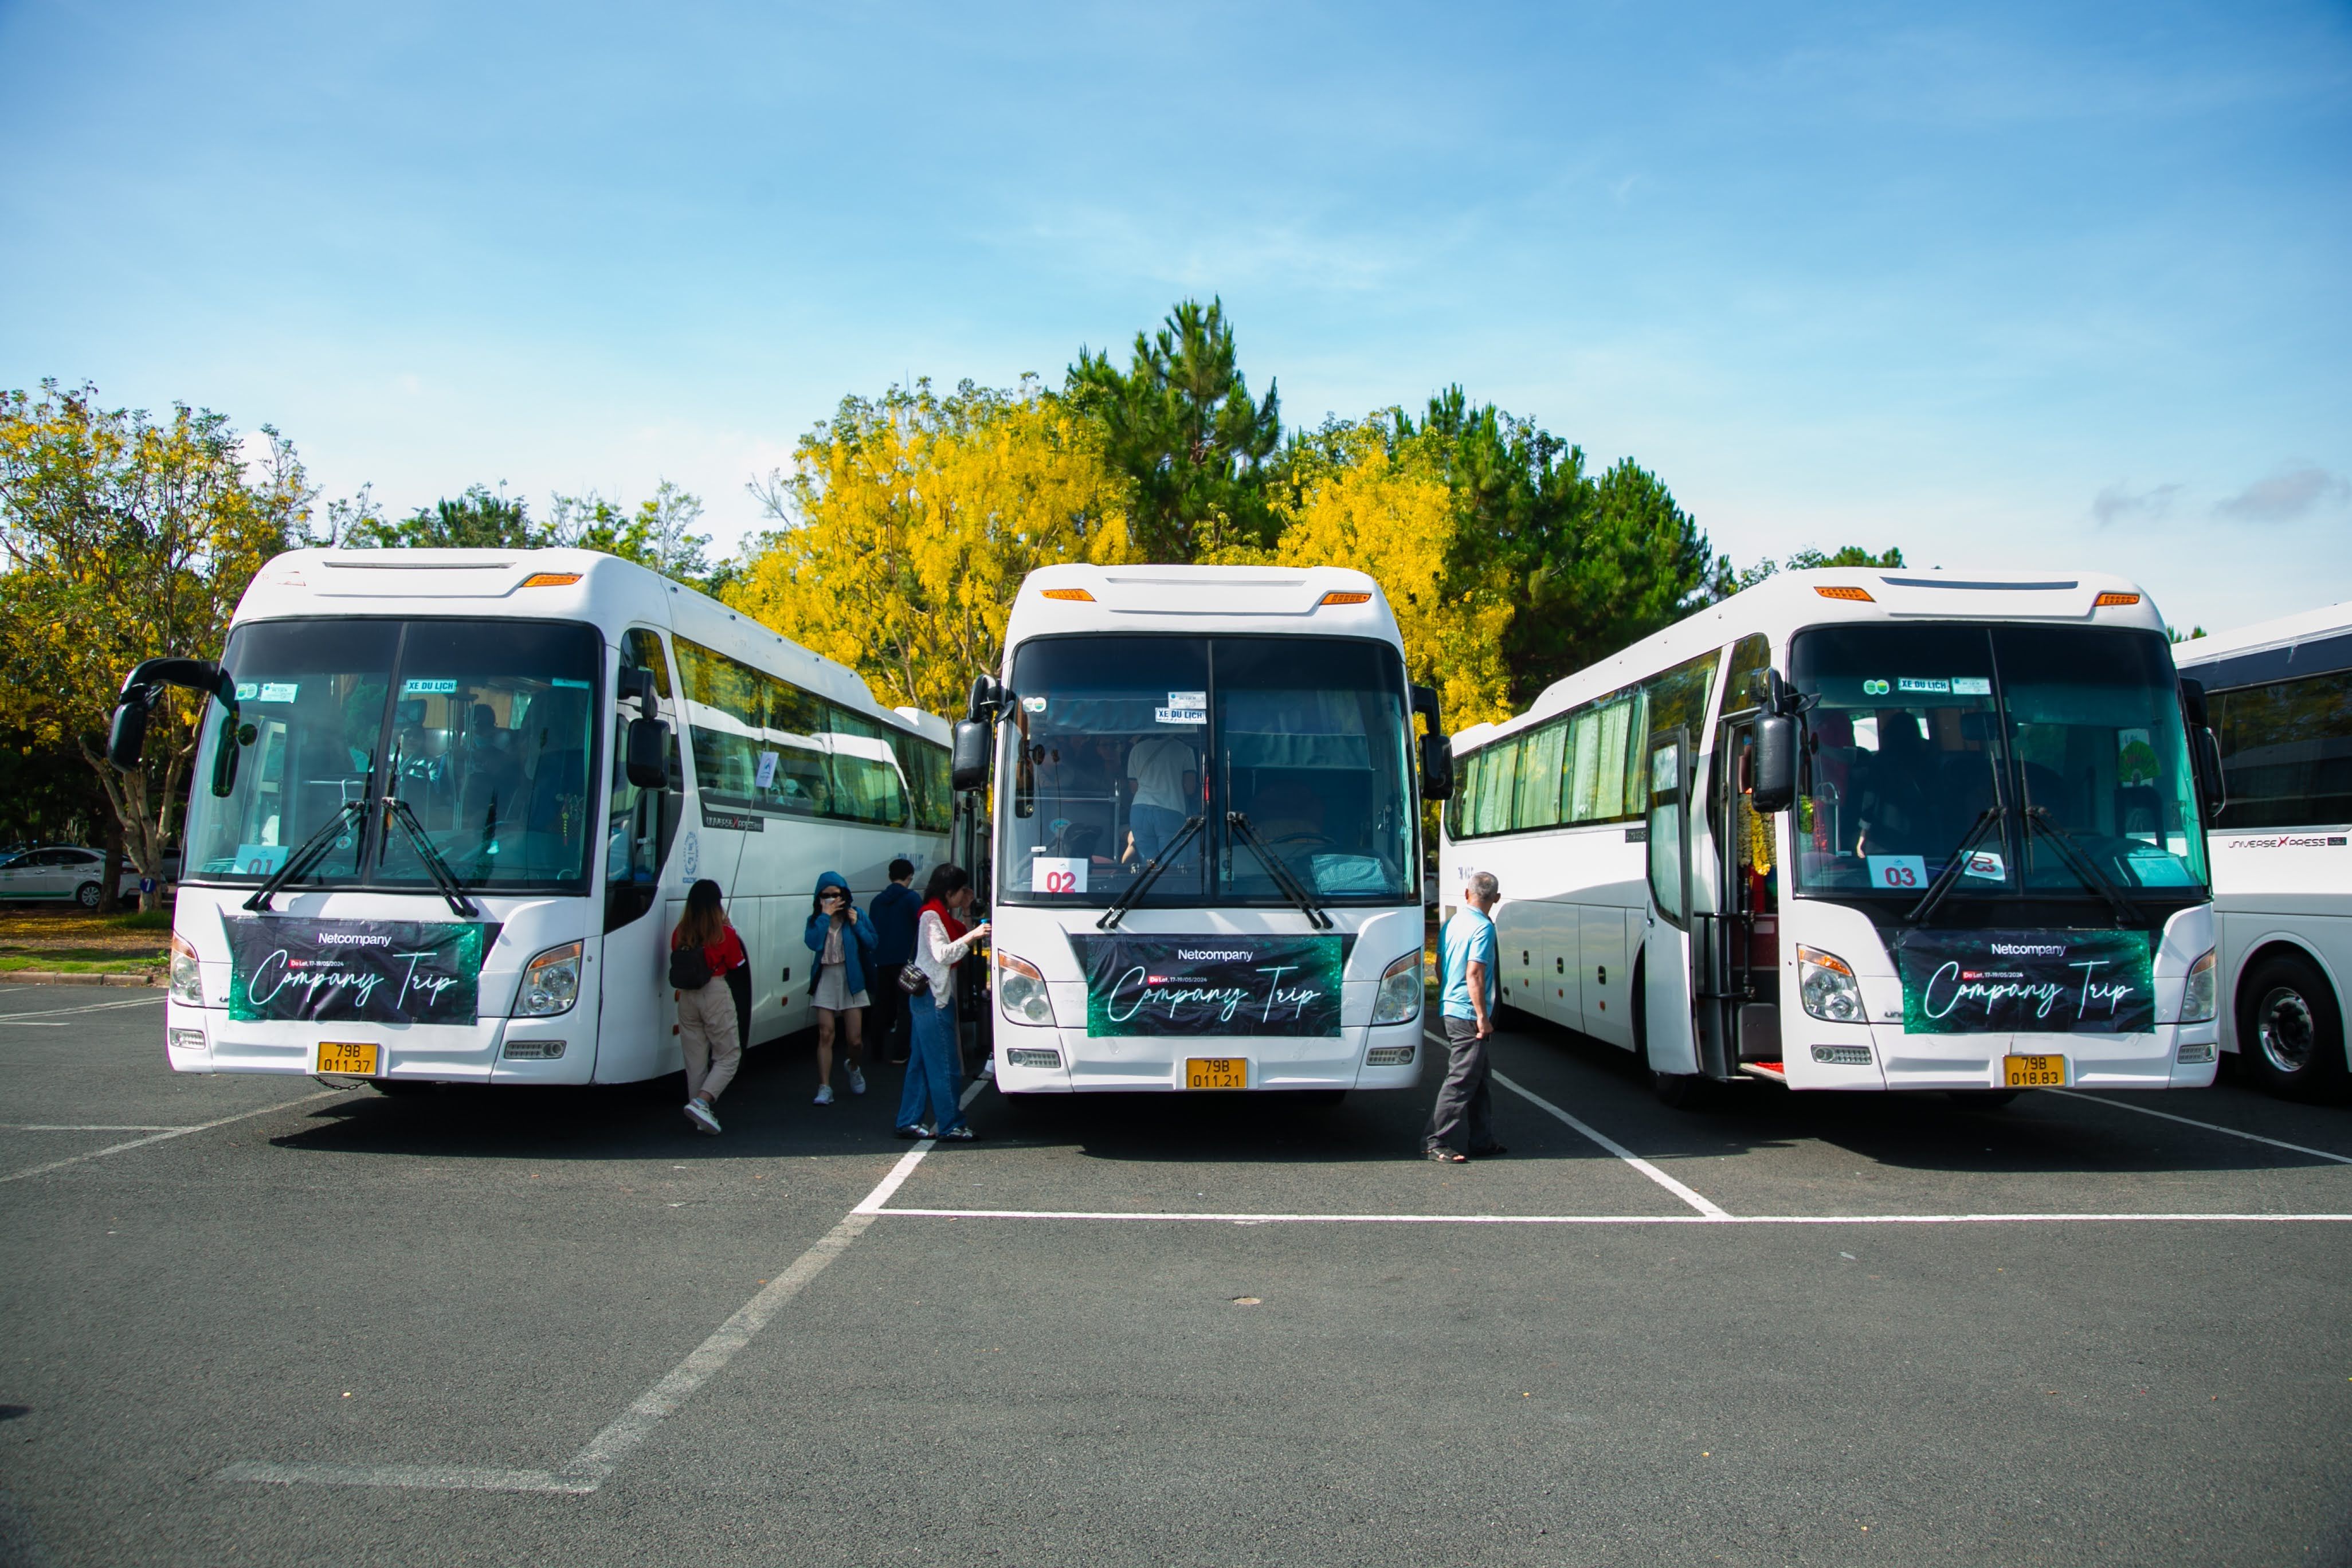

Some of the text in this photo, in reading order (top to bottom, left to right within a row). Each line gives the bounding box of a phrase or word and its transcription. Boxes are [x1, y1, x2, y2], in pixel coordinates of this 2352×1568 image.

[1046, 872, 1076, 893] 02
[1884, 867, 1917, 887] 03
[144, 878, 152, 892] 7
[318, 933, 392, 947] Netcompany
[1178, 949, 1253, 962] Netcompany
[1991, 943, 2066, 957] Netcompany
[249, 949, 458, 1010] Company Trip
[1107, 966, 1321, 1024] Company Trip
[1924, 960, 2134, 1019] Company Trip
[336, 1044, 360, 1057] 79B
[324, 1059, 370, 1072] 011.37
[1204, 1060, 1229, 1072] 79B
[2021, 1057, 2047, 1069] 79B
[1193, 1075, 1238, 1087] 011.21
[2012, 1072, 2058, 1085] 018.83
